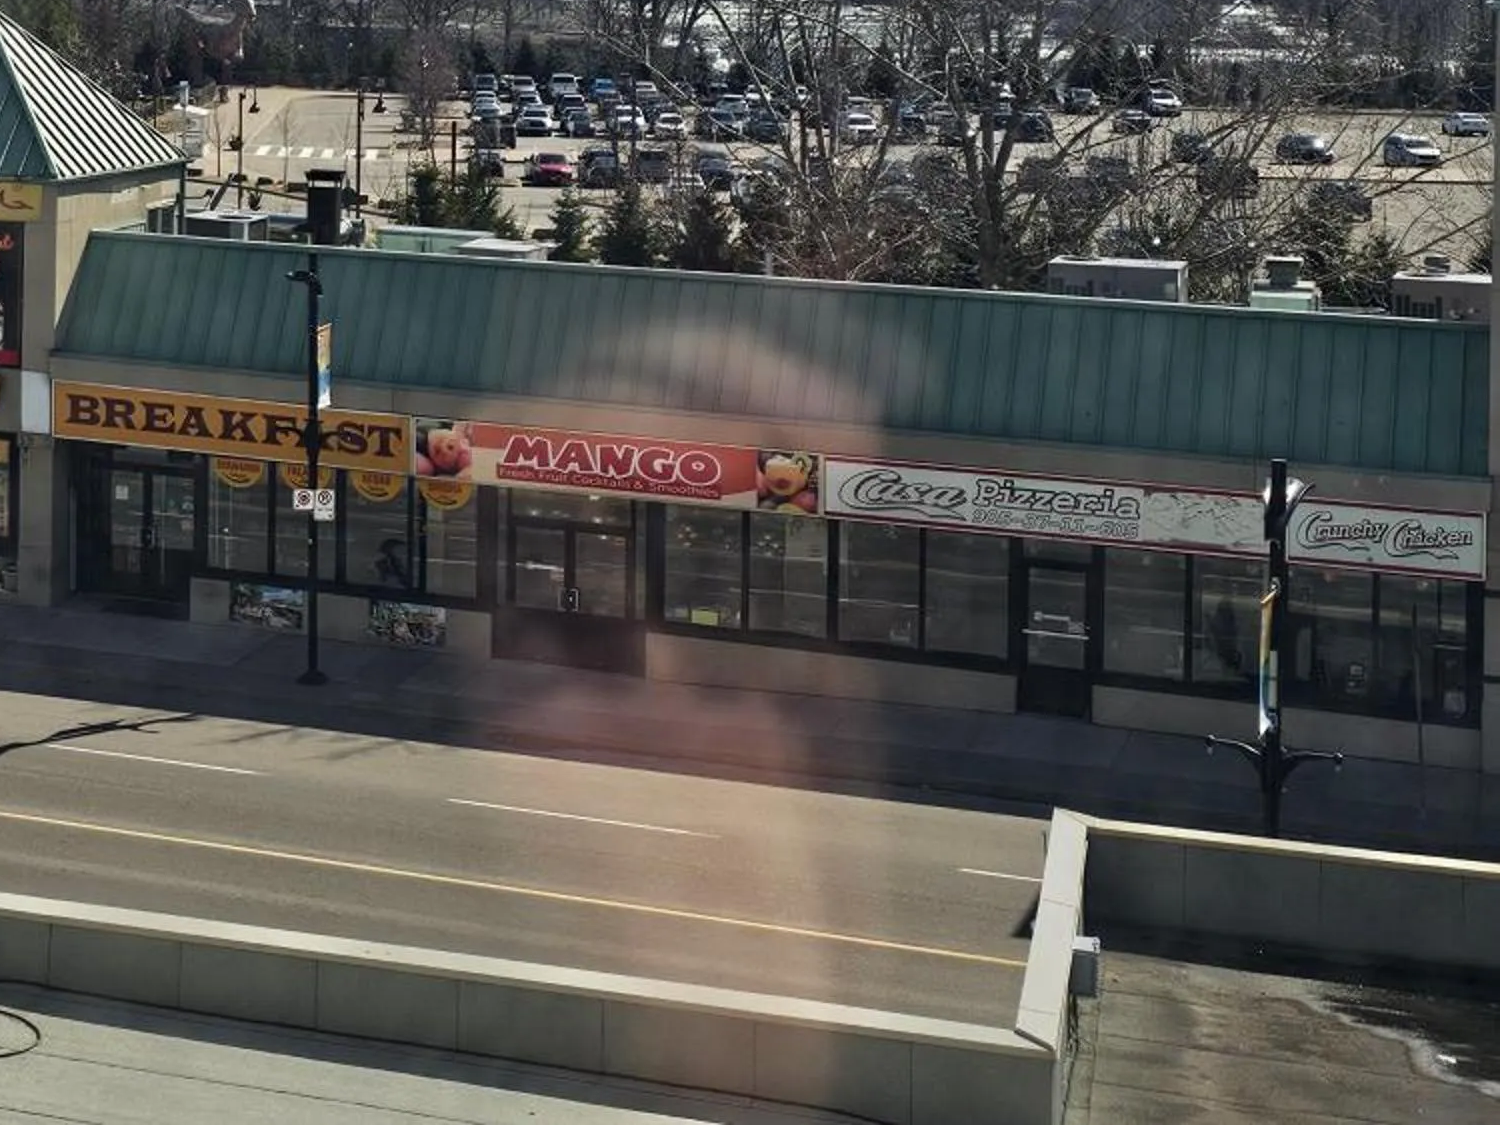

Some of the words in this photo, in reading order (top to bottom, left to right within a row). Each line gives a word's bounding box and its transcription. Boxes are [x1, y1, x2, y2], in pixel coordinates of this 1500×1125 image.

[500, 435, 721, 486] MANGO
[539, 471, 569, 482] Fruit
[573, 475, 631, 489] Cocktails
[633, 480, 644, 489] &
[838, 469, 967, 521] Casa
[972, 479, 1140, 519] Pizzeria
[1297, 511, 1389, 550] Crunchy
[1384, 519, 1473, 559] Chicken
